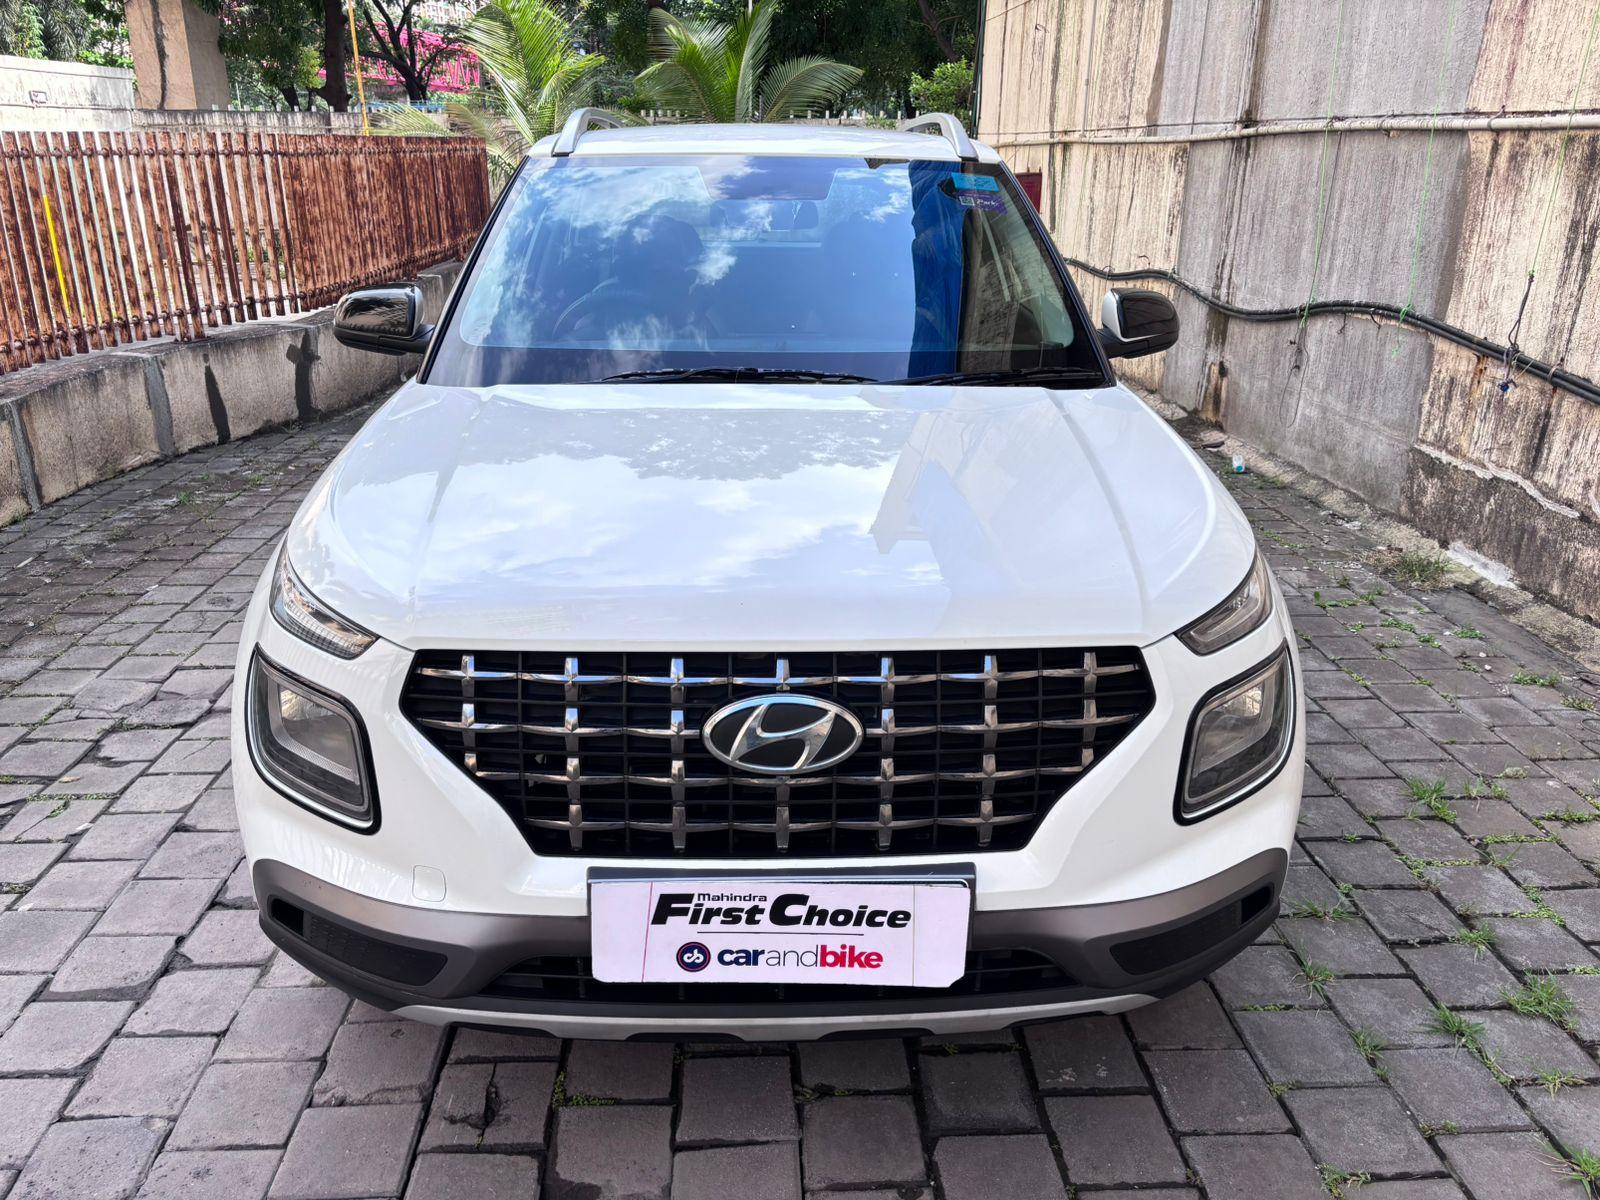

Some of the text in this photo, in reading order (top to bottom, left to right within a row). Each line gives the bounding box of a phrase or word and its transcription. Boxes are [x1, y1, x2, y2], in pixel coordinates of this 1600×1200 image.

[651, 893, 912, 928] First Choice
[697, 893, 767, 902] Mahindra
[717, 944, 884, 970] carandbike
